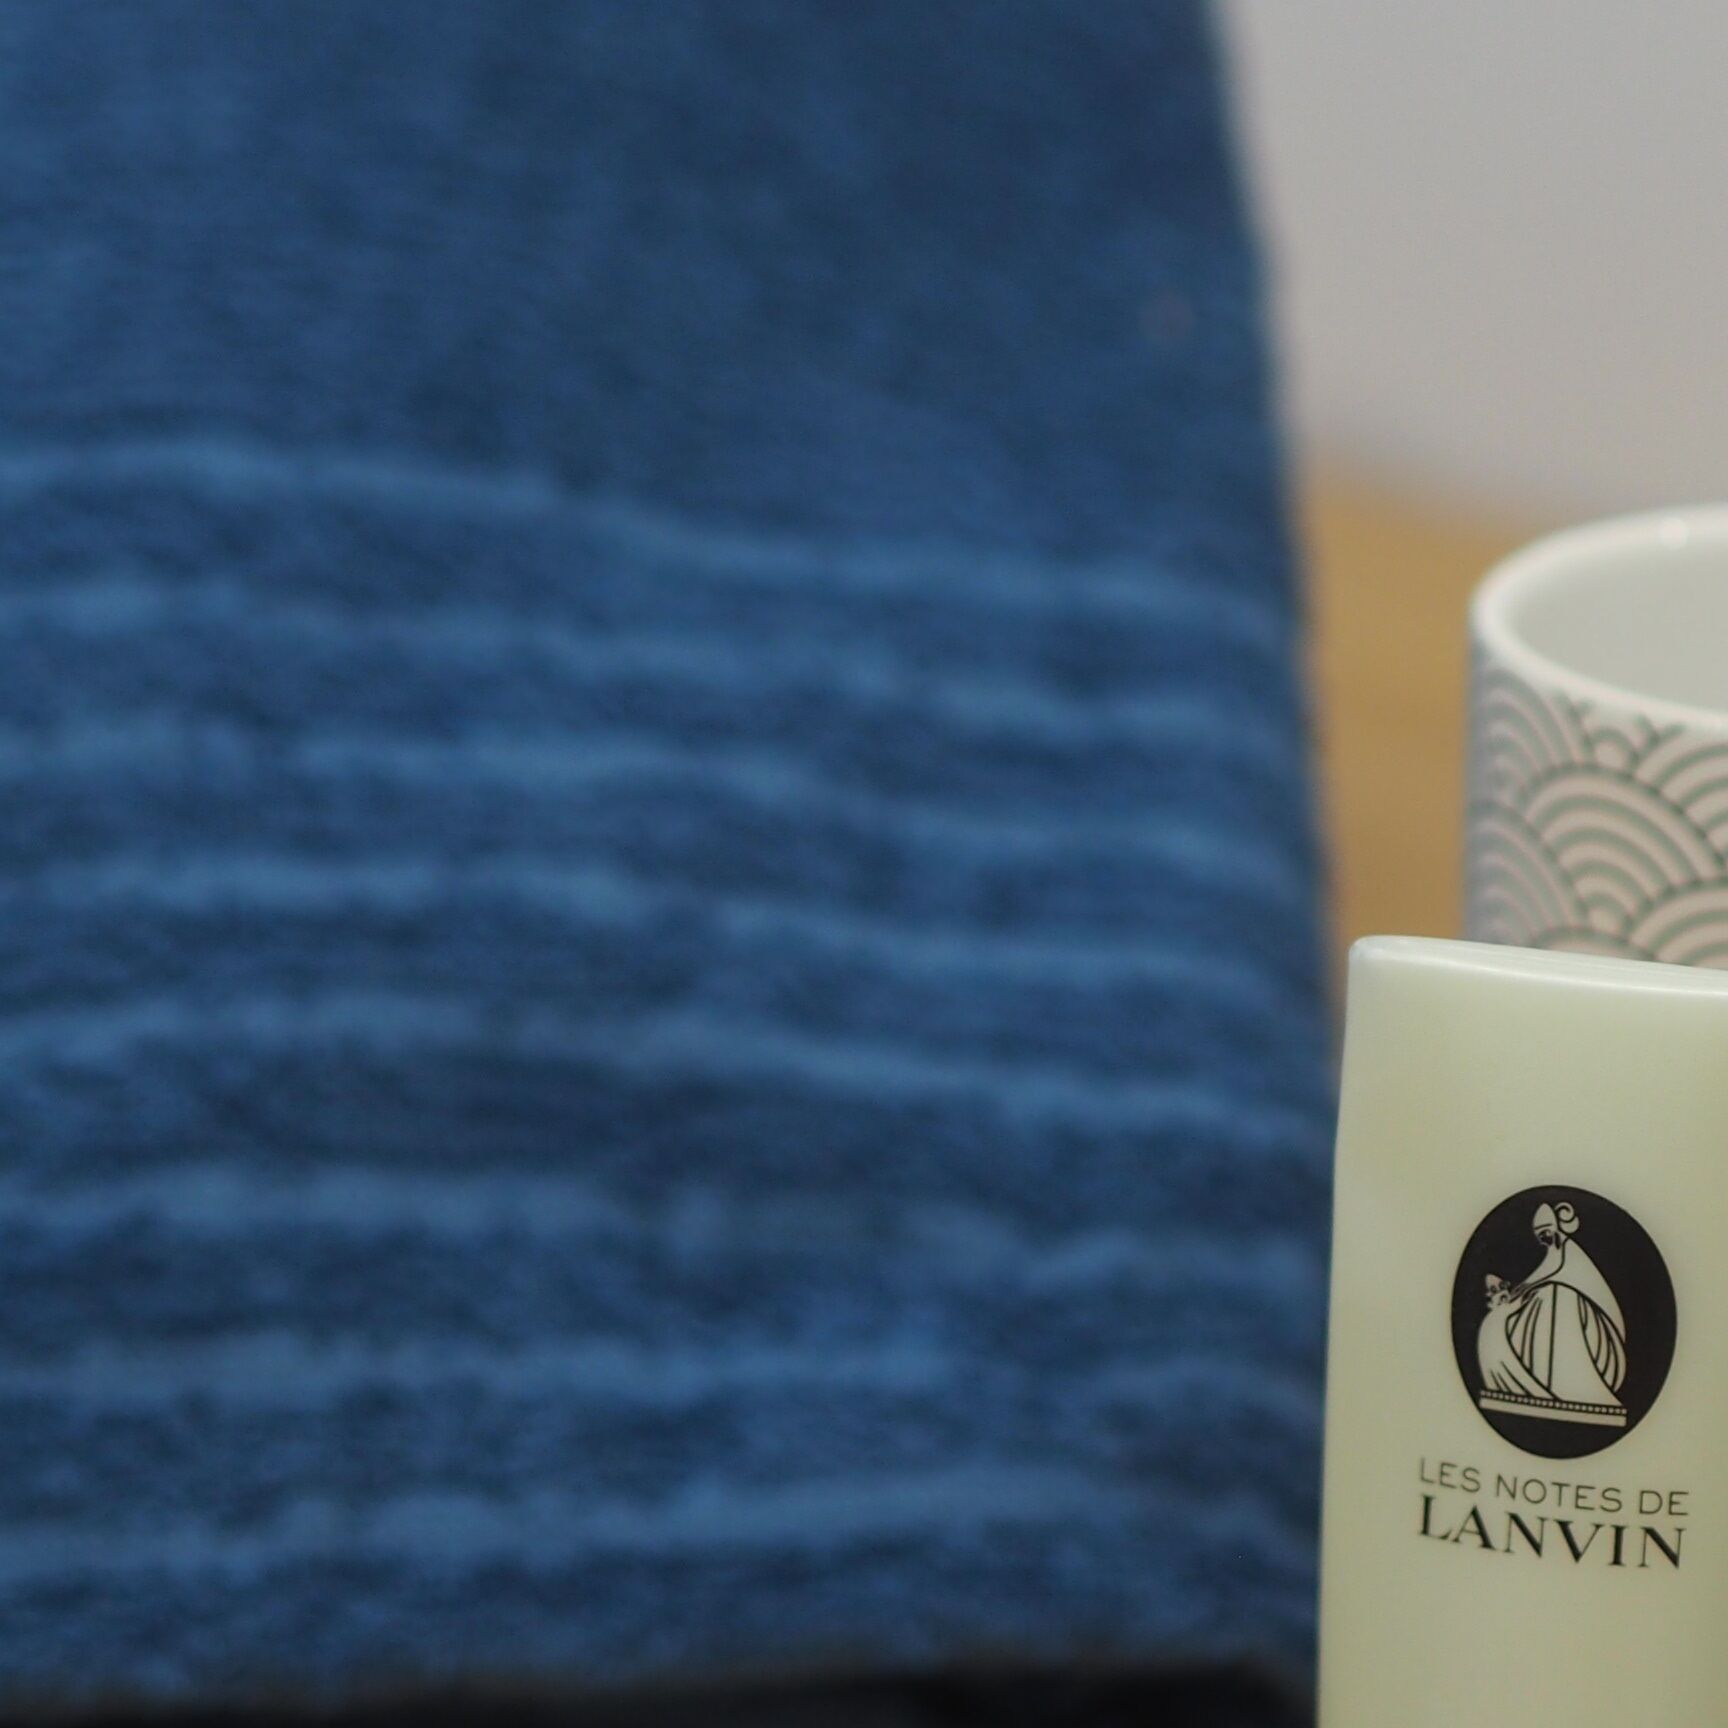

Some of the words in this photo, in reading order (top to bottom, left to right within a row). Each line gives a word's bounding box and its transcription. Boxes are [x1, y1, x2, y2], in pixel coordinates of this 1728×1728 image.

[1418, 1456, 1482, 1494] LES
[1495, 1473, 1623, 1513] NOTES
[1638, 1489, 1690, 1517] DE
[1417, 1493, 1687, 1570] LANVIN
